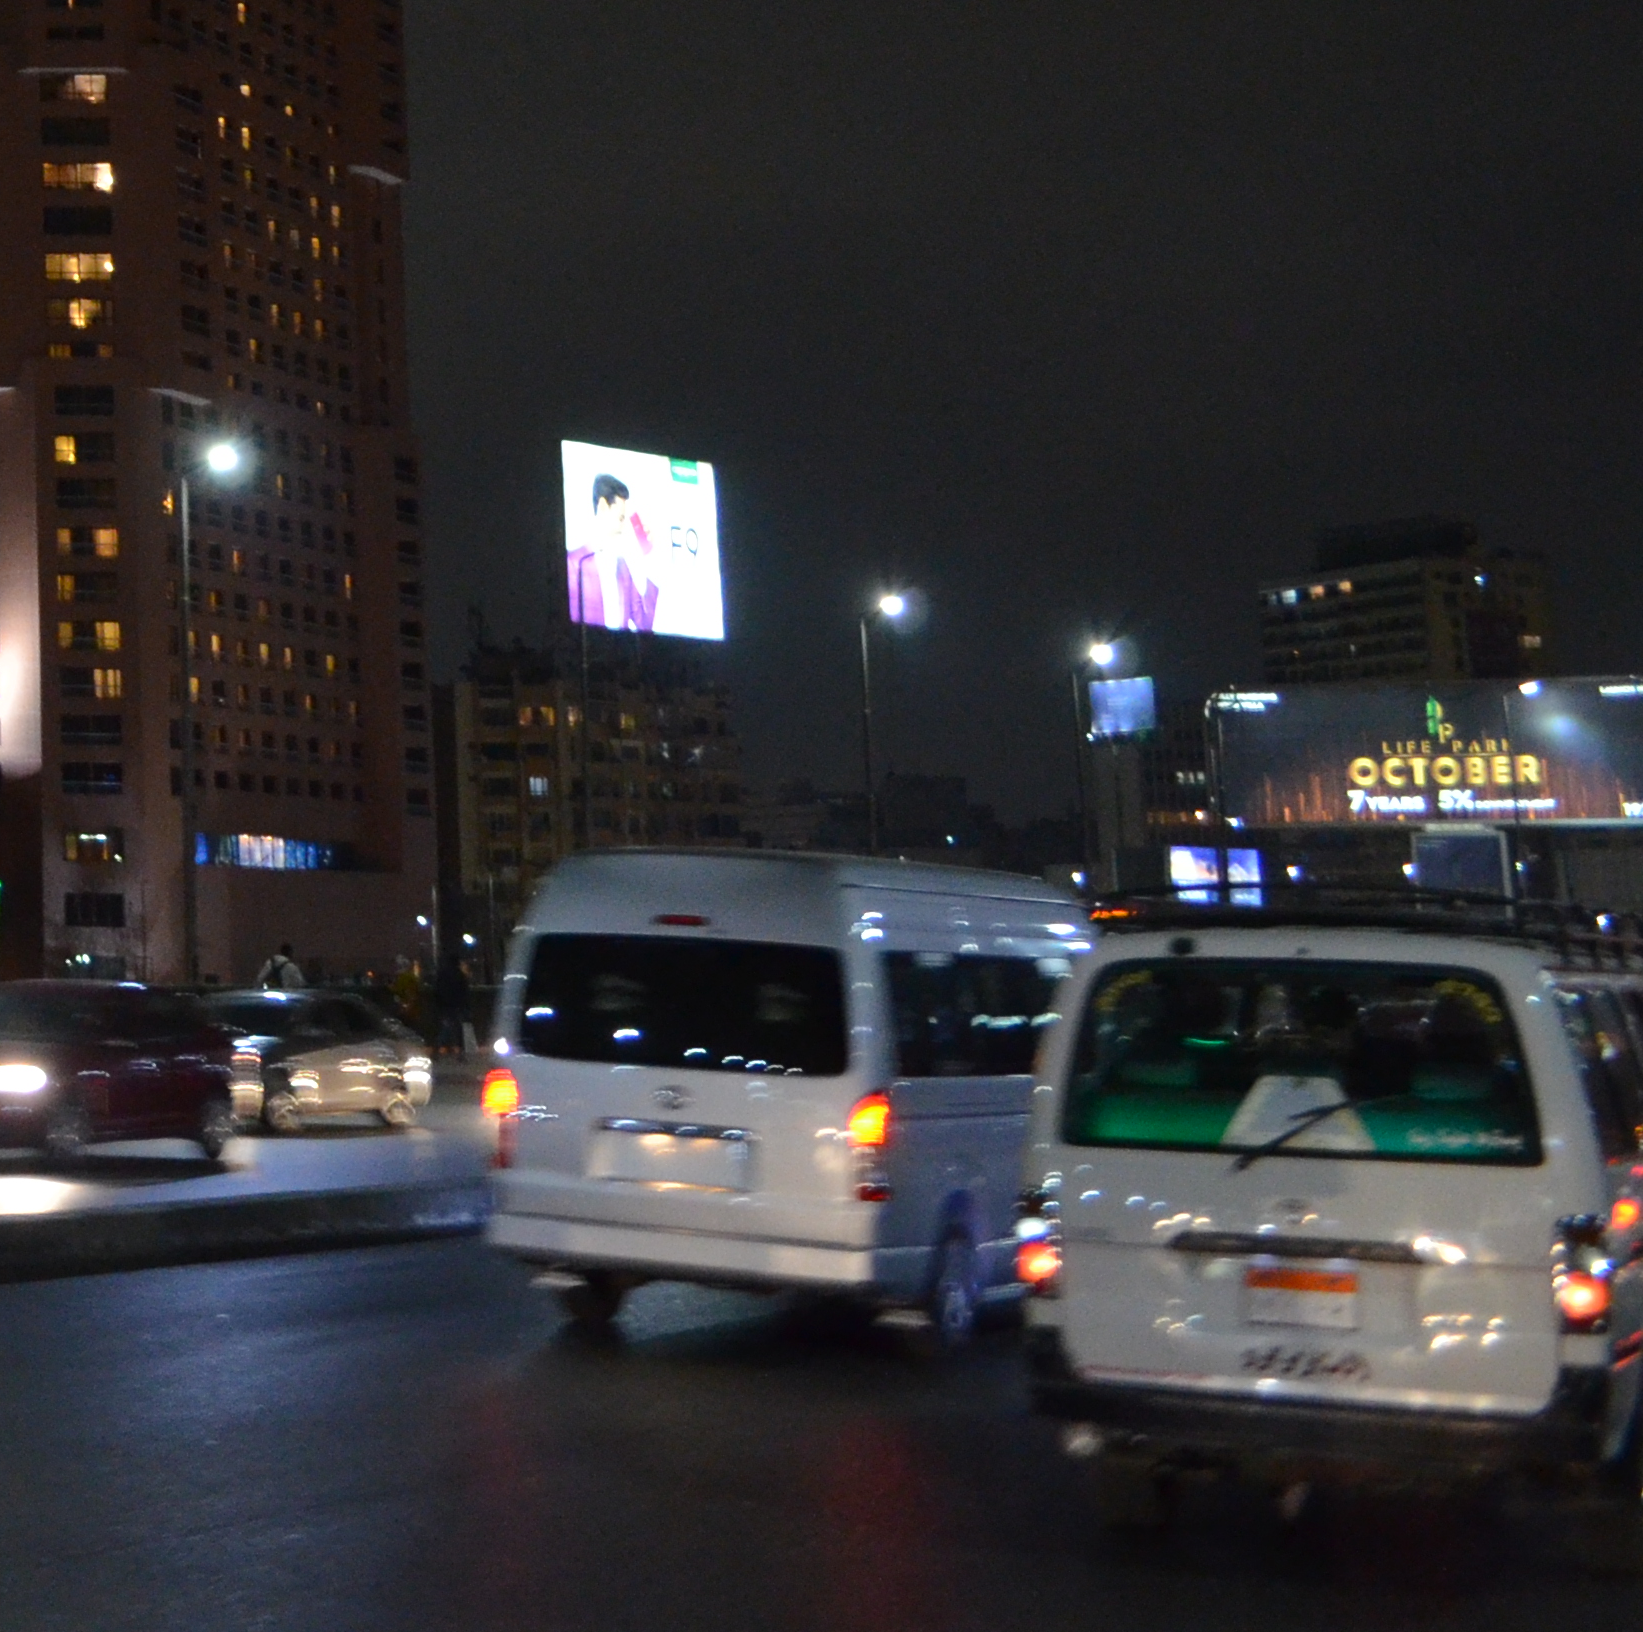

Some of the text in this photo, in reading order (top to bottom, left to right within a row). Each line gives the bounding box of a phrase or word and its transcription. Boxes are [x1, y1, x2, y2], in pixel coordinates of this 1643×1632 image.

[1382, 740, 1433, 755] LIFE
[1348, 754, 1541, 787] OCTOBER
[1365, 796, 1426, 812] YEARS
